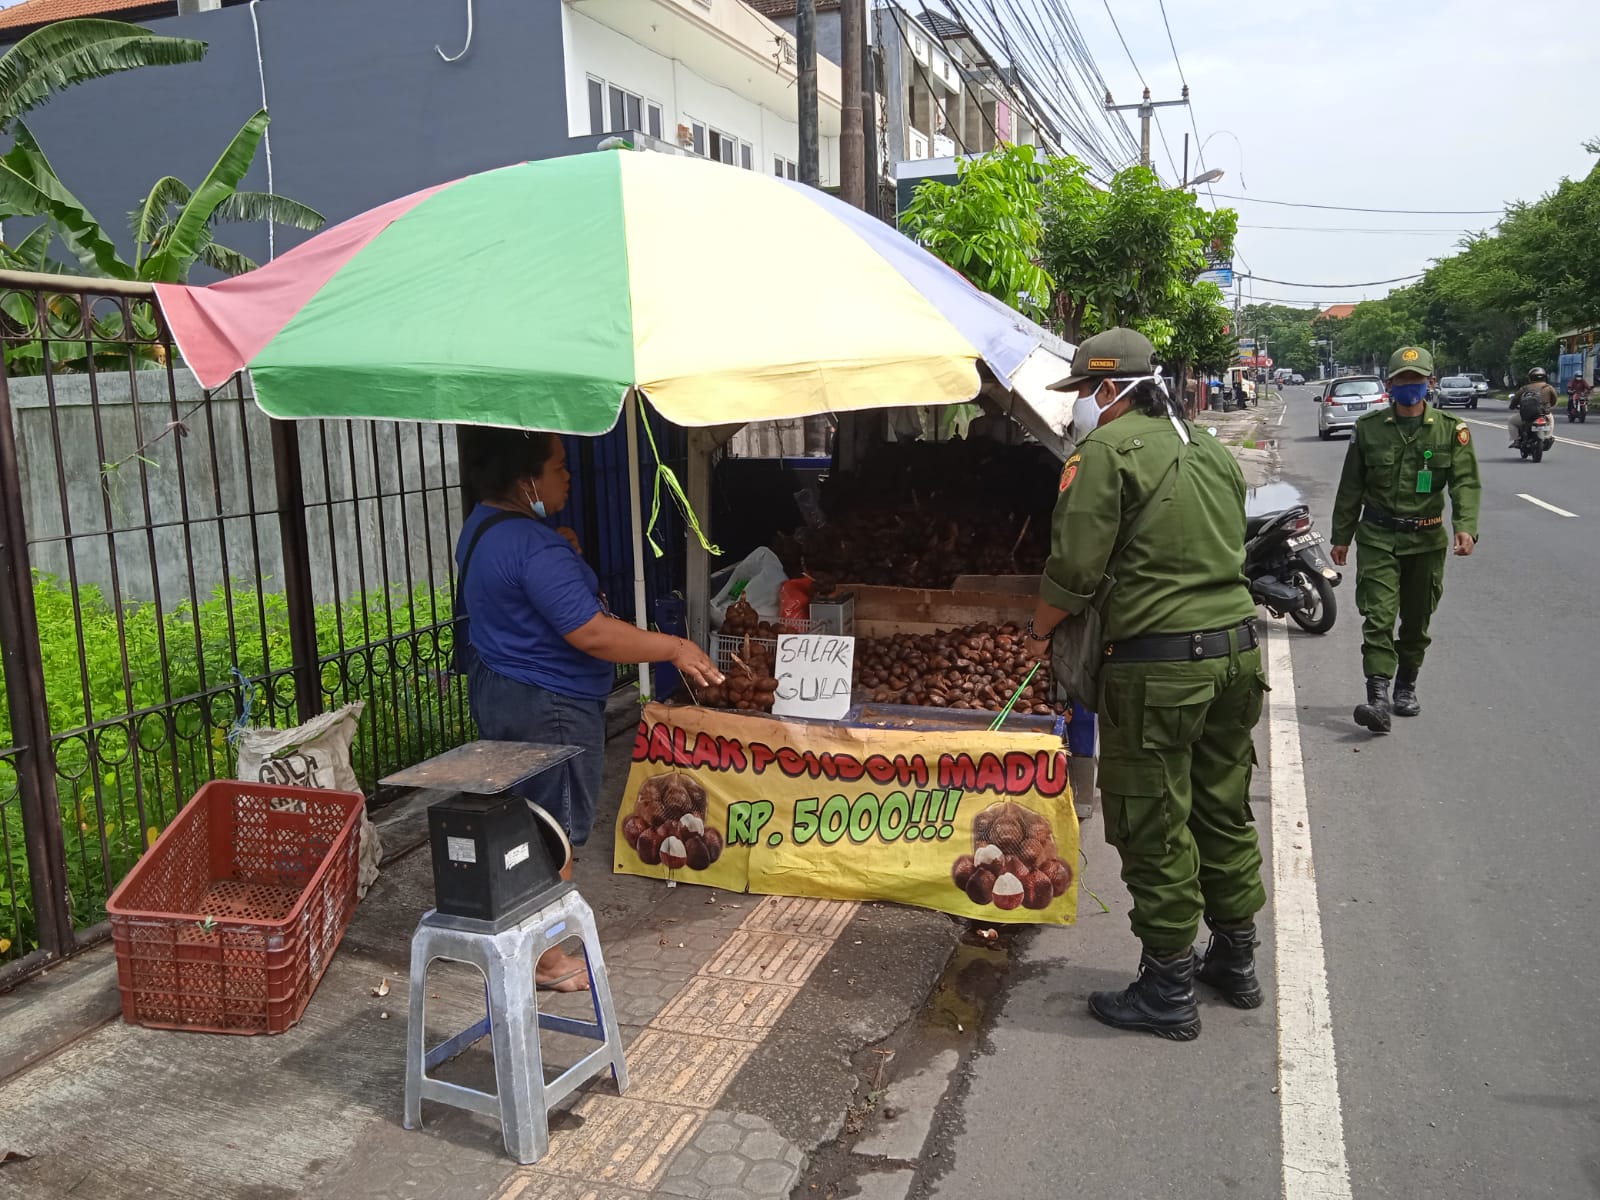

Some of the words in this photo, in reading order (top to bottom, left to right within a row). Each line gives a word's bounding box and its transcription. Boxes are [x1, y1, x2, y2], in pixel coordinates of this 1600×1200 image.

[780, 634, 850, 665] SALAK
[775, 673, 850, 702] GULA
[632, 719, 748, 774] SALAK
[748, 741, 929, 787] PONDOH
[937, 749, 1068, 797] MADU
[727, 799, 784, 847] RP.
[792, 788, 964, 846] 5000!!!
